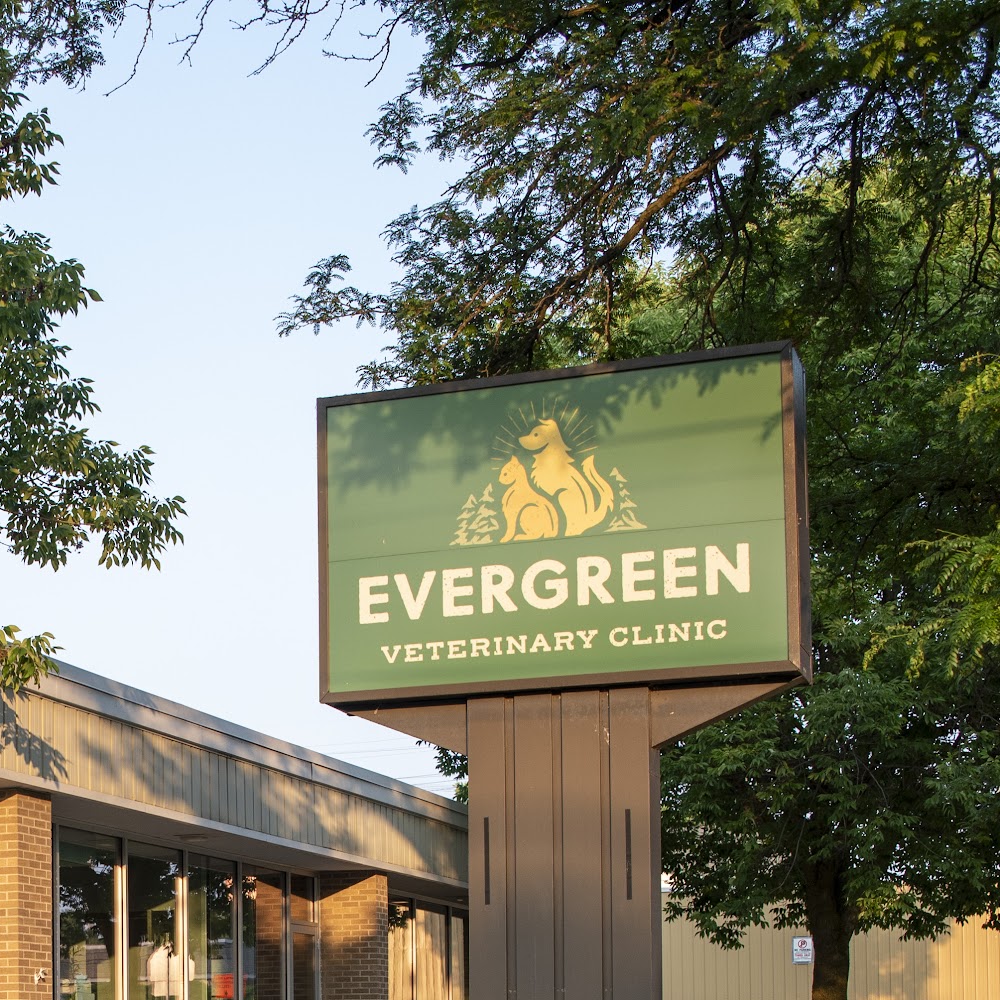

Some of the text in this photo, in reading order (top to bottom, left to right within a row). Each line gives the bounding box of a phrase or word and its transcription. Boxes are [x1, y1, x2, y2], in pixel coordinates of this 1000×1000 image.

[358, 542, 751, 625] EVERGREEN
[380, 619, 728, 664] VETERINARY CLINIC
